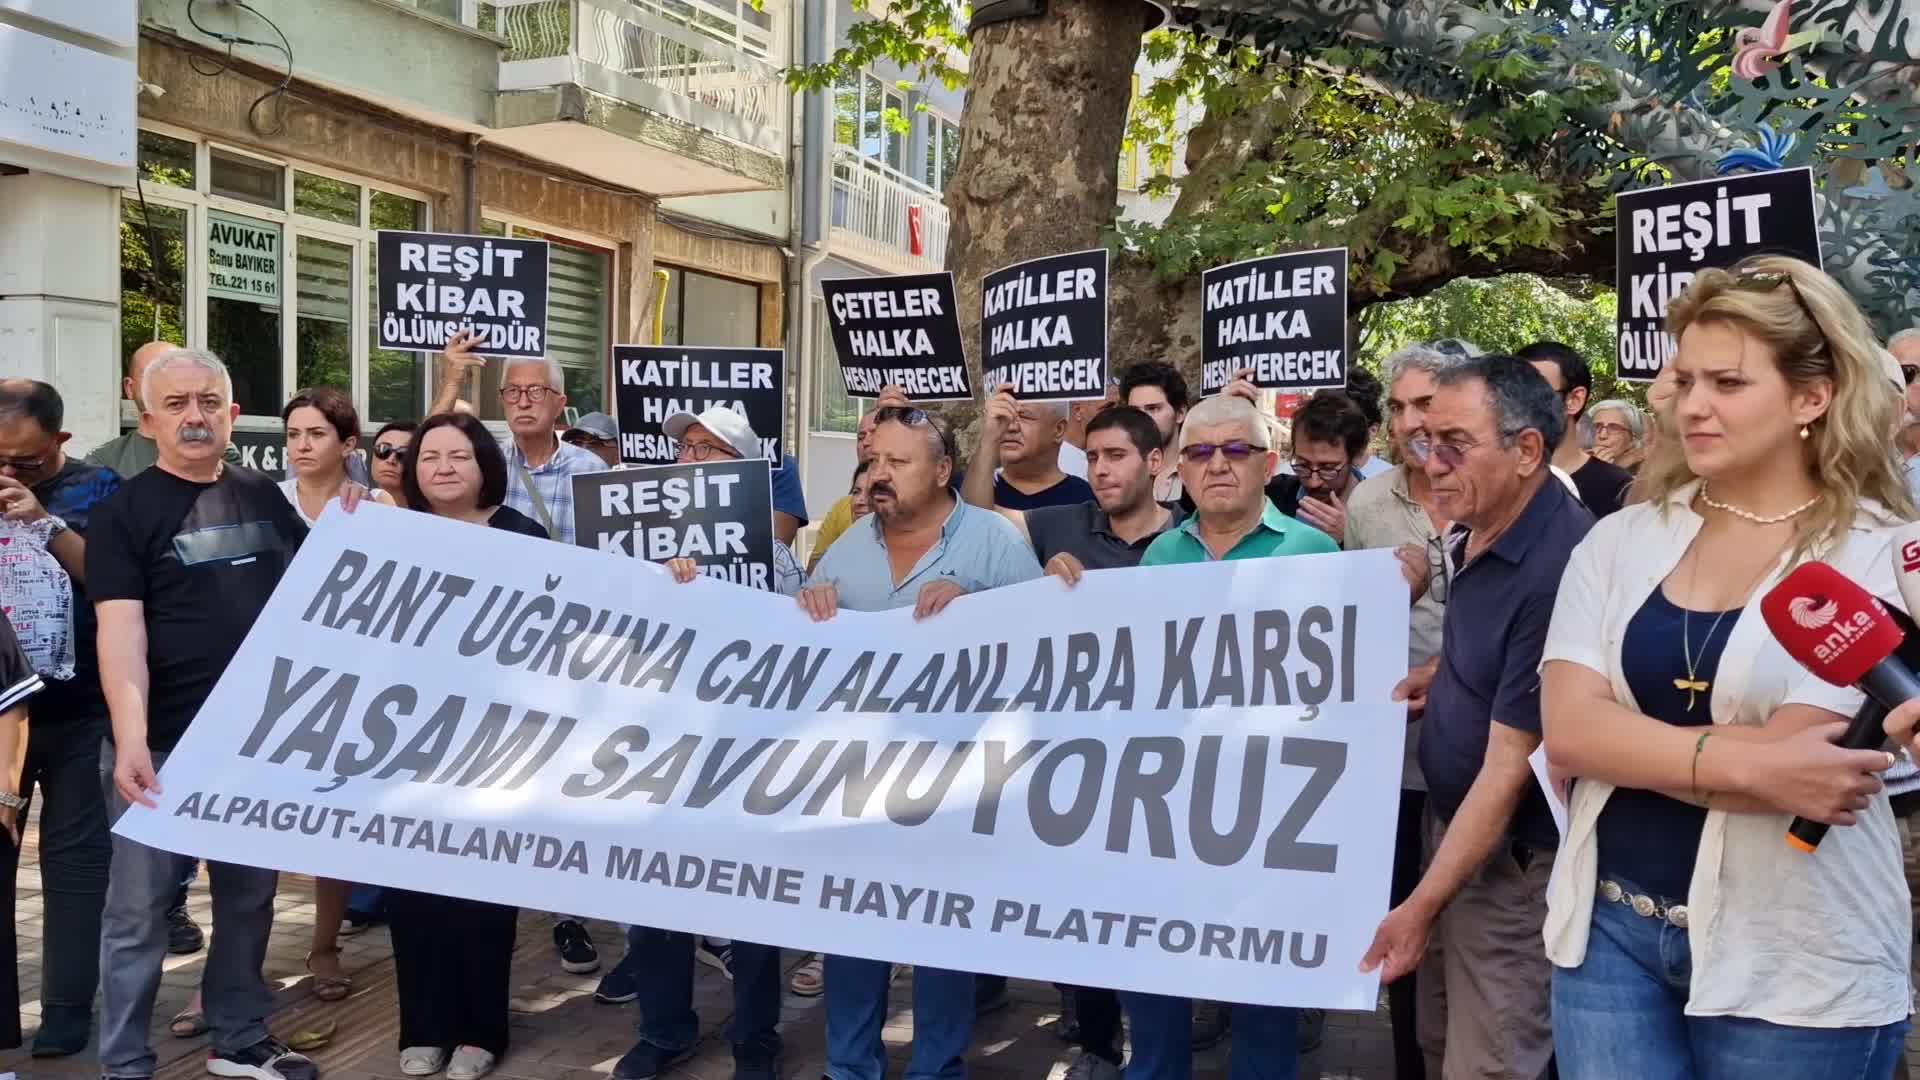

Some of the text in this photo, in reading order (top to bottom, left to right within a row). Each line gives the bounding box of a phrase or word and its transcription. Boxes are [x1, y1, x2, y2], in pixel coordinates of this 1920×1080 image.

[210, 222, 275, 252] AVUKAT
[1632, 186, 1772, 262] REŞİT
[209, 248, 233, 268] Banu
[400, 241, 523, 282] REŞİT
[209, 272, 275, 294] TEL.221 15 61
[396, 277, 526, 318] KİBAR
[983, 267, 1097, 319] KATİLLER
[1206, 265, 1336, 312] KATİLLER
[831, 288, 944, 326] ÇETELER
[848, 328, 935, 357] HALKA
[990, 314, 1074, 357] HALKA
[1217, 309, 1312, 347] HALKA
[621, 354, 774, 389] KATİLLER
[842, 366, 968, 394] HESAP VERECEK
[1011, 357, 1101, 393] VERECEK
[1244, 350, 1342, 382] VERECEK
[599, 468, 740, 520] REŞİT
[597, 521, 749, 561] KİBAR
[301, 548, 1358, 721] RANT UĞRUNA CAN ALANLARA KARŞI
[1813, 610, 1871, 660] anka
[237, 656, 1348, 874] YAŞAMI SAVUNUYORUZ
[604, 844, 804, 906] MADENE
[818, 874, 976, 930] HAYIR
[990, 897, 1329, 969] PLATFORMU
